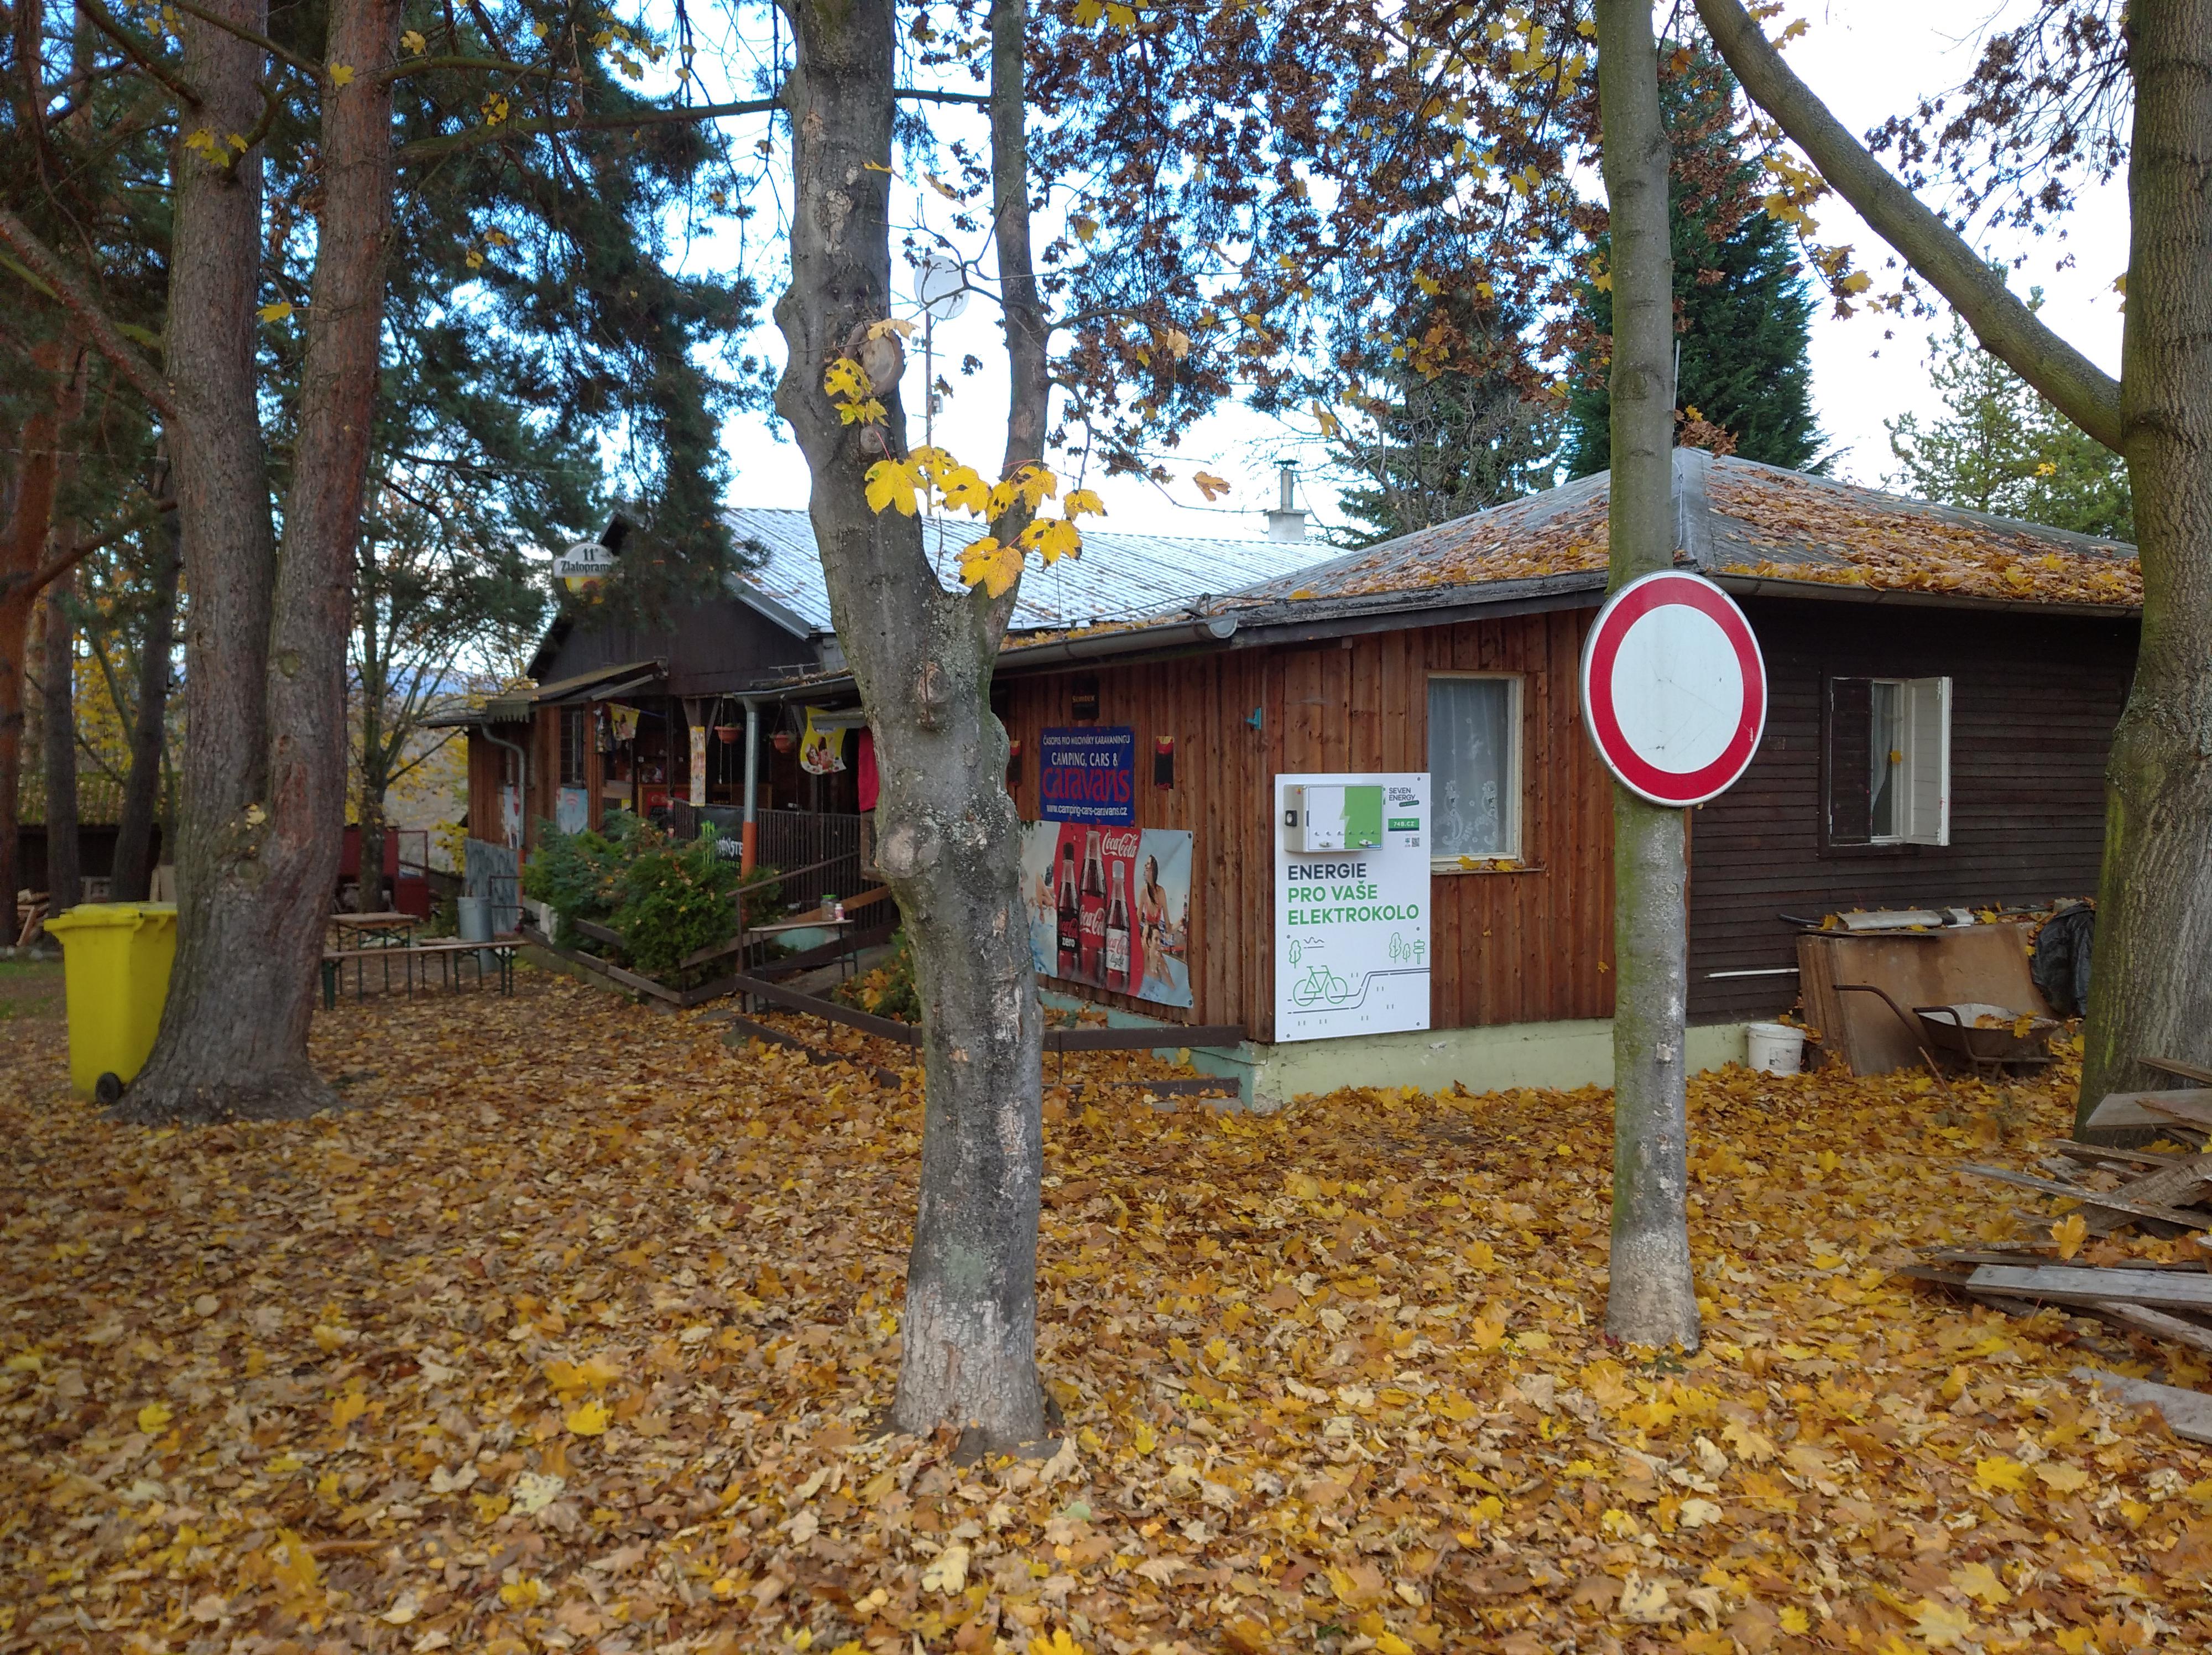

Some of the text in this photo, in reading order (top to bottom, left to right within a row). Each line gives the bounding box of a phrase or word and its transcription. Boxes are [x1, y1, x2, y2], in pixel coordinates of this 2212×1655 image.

[1051, 752, 1118, 767] CAMPING, CARS &
[1042, 767, 1130, 803] caravans
[1046, 804, 1128, 817] www.camping-cars-caravans.cz
[1102, 829, 1139, 858] Coca-Cola
[1288, 863, 1366, 881] ENERGIE
[1288, 881, 1378, 903] PRO VAŠE
[1288, 904, 1419, 925] ELEKTROKOLO
[1062, 937, 1076, 948] zero
